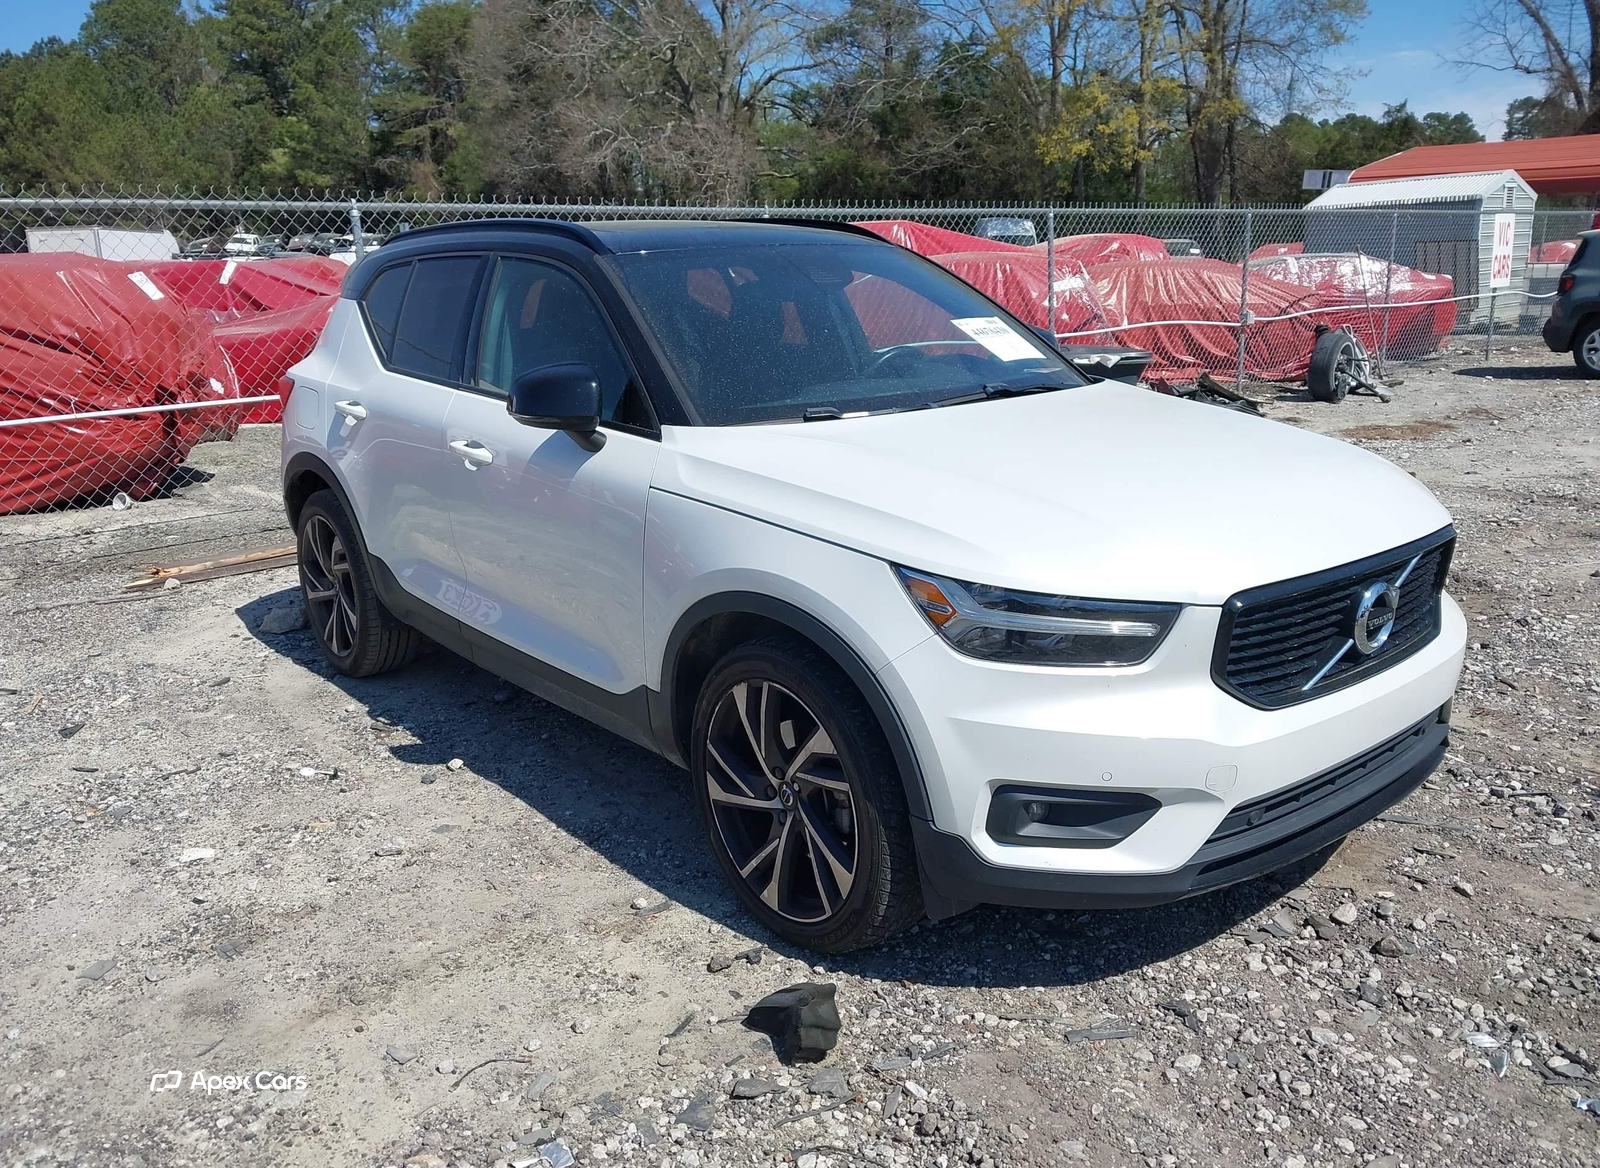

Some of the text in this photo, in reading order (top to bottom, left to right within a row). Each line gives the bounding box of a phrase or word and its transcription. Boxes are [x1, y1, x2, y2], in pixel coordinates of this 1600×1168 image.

[1498, 221, 1511, 247] VIC
[1492, 253, 1511, 279] CARS
[1367, 612, 1393, 628] VOLVO
